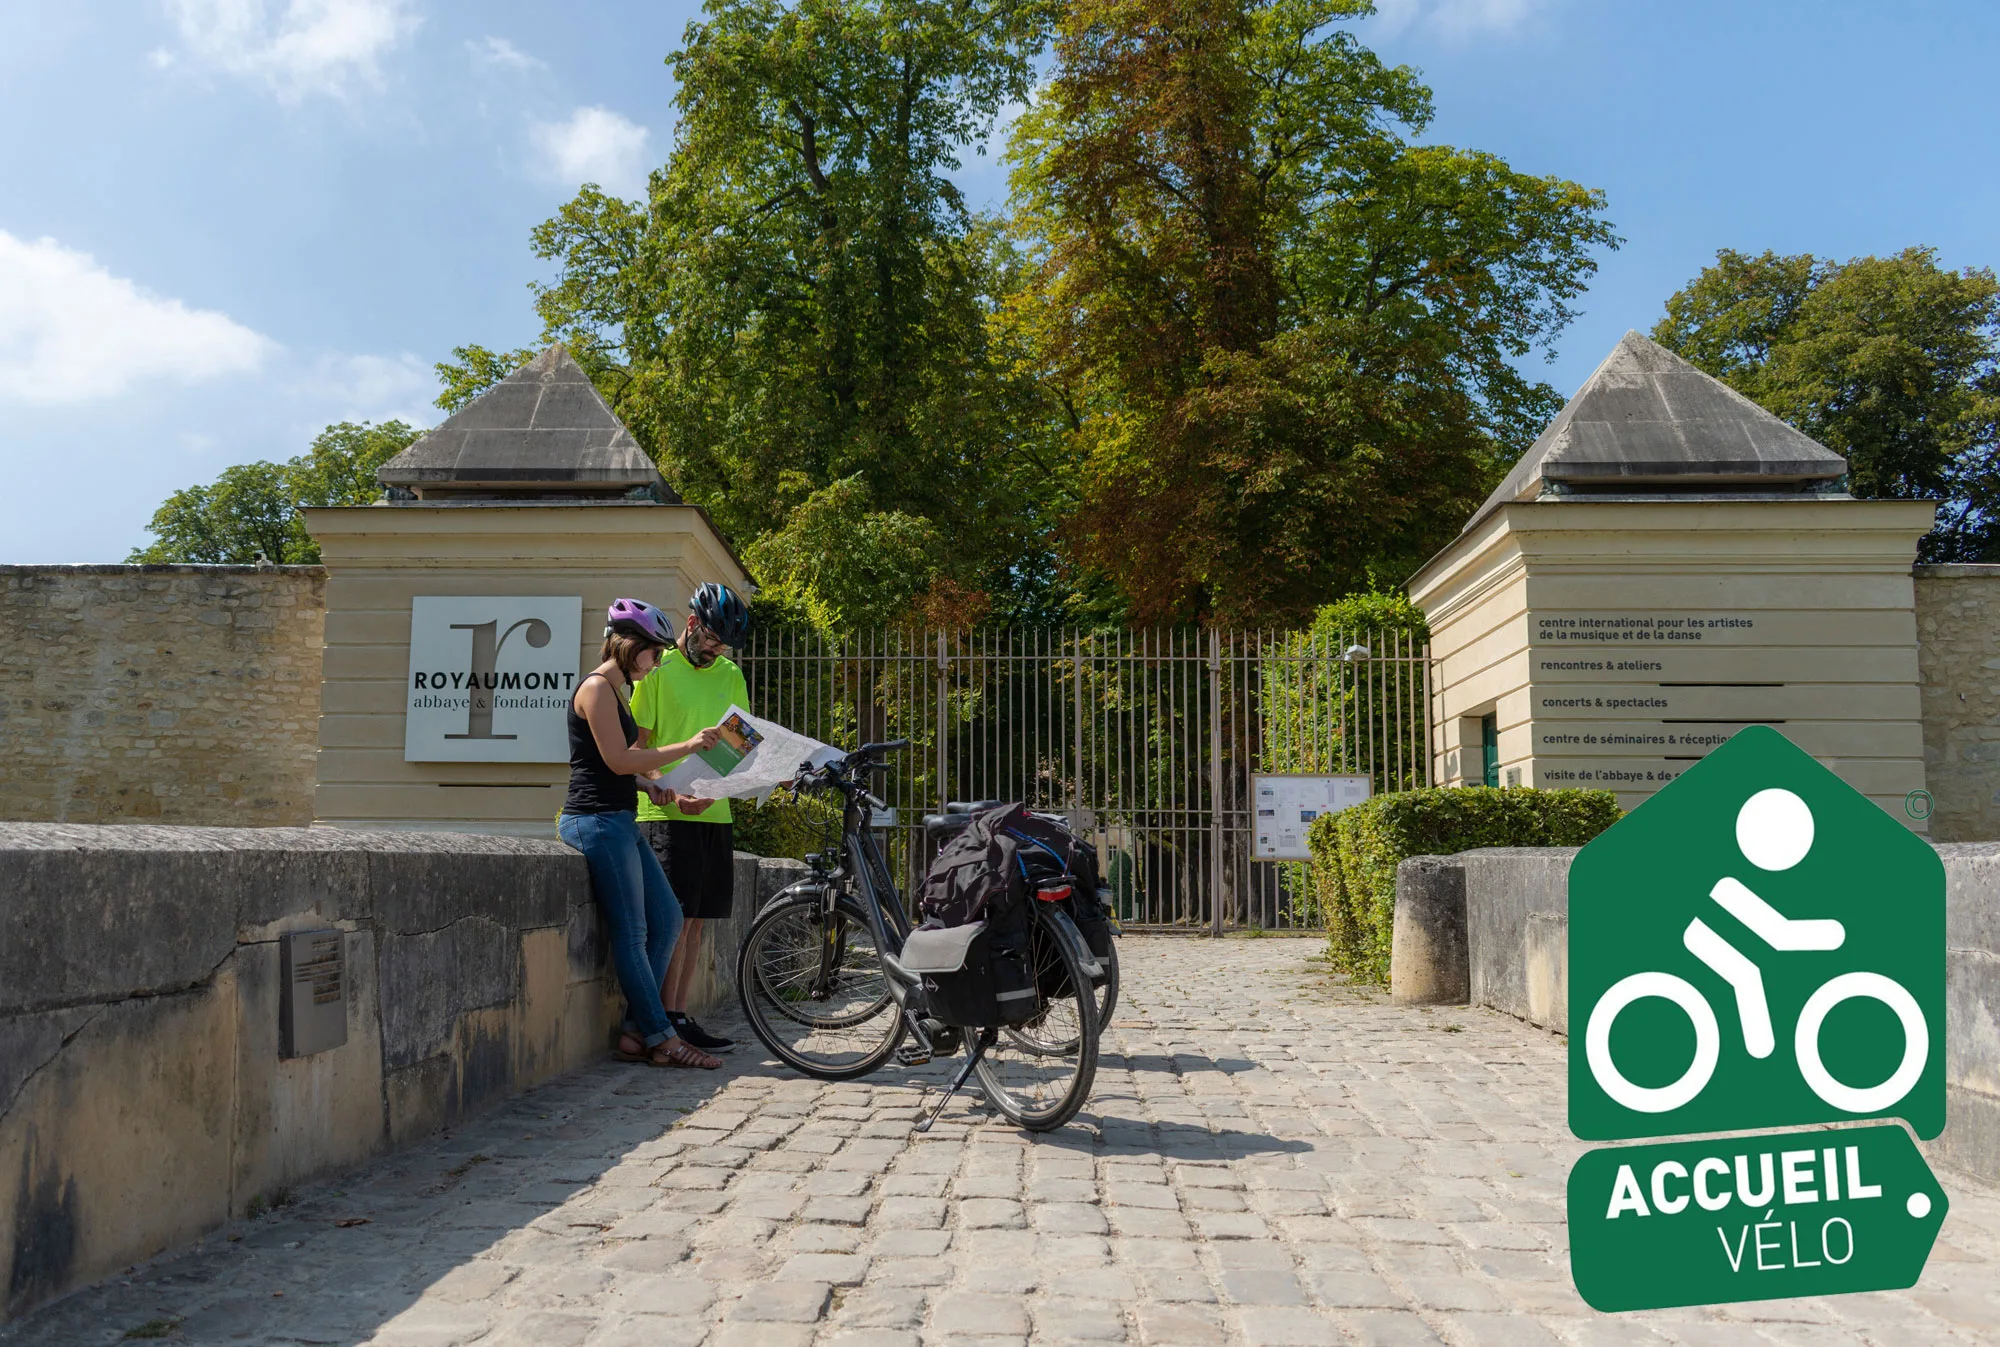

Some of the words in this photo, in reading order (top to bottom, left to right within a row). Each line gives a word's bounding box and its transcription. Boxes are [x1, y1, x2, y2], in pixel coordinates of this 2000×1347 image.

[1539, 618, 1576, 628] centre
[1579, 617, 1654, 628] international
[1657, 619, 1684, 630] pour
[1687, 617, 1704, 628] les
[1708, 618, 1753, 628] artistes
[1539, 629, 1553, 640] de
[1557, 629, 1567, 640] la
[1570, 630, 1619, 642] musique
[1622, 630, 1633, 640] et
[1635, 629, 1650, 640] de
[1654, 629, 1664, 640] la
[1667, 629, 1702, 640] danse
[1541, 661, 1603, 670] rencontres
[1606, 661, 1614, 670] &
[1617, 660, 1662, 671] ateliers
[414, 672, 575, 690] ROYAUMONT
[414, 695, 470, 711] abbaye
[476, 697, 486, 709] &
[1542, 698, 1592, 708] concerts
[1595, 698, 1603, 708] &
[1607, 698, 1668, 709] spectacles
[1543, 735, 1579, 744] centre
[1583, 734, 1597, 744] de
[1600, 733, 1665, 744] séminaires
[1669, 735, 1676, 744] &
[1680, 733, 1731, 747] réceptio
[1544, 770, 1575, 780] visite
[1579, 770, 1593, 780] de
[1647, 771, 1654, 781] &
[1658, 770, 1671, 780] de
